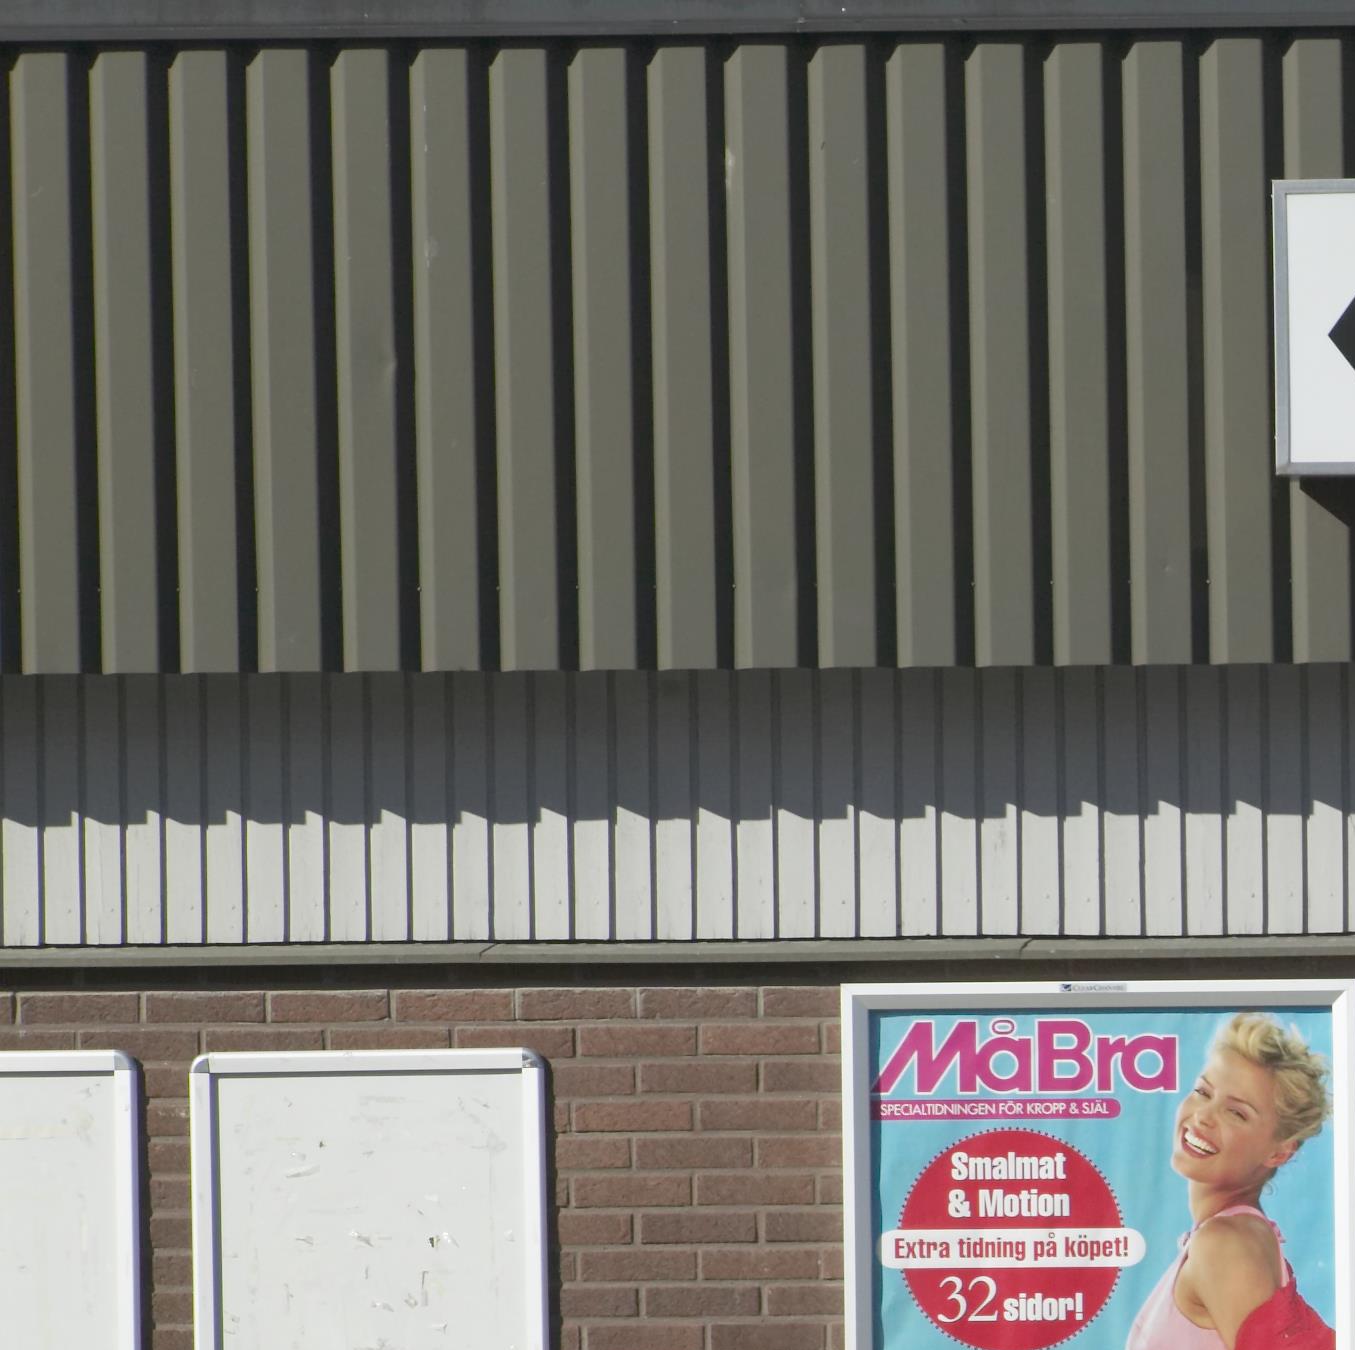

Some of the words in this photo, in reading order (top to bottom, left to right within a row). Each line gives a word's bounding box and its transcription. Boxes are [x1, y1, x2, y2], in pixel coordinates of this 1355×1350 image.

[872, 1019, 1179, 1095] MåBra
[880, 1103, 995, 1116] SPECIALTIDNINGEN
[999, 1101, 1023, 1115] FÖR
[1027, 1102, 1066, 1114] KROPP
[1069, 1102, 1079, 1114] &
[1082, 1100, 1109, 1114] SJÄL
[951, 1152, 1066, 1181] Smalmat
[948, 1189, 971, 1218] &
[978, 1189, 1070, 1217] Motion
[894, 1238, 950, 1259] Extra
[958, 1237, 1026, 1261] tidning
[1033, 1232, 1057, 1261] på
[1065, 1235, 1128, 1260] köpet!
[937, 1276, 998, 1322] 32
[1003, 1292, 1083, 1321] sidor!
